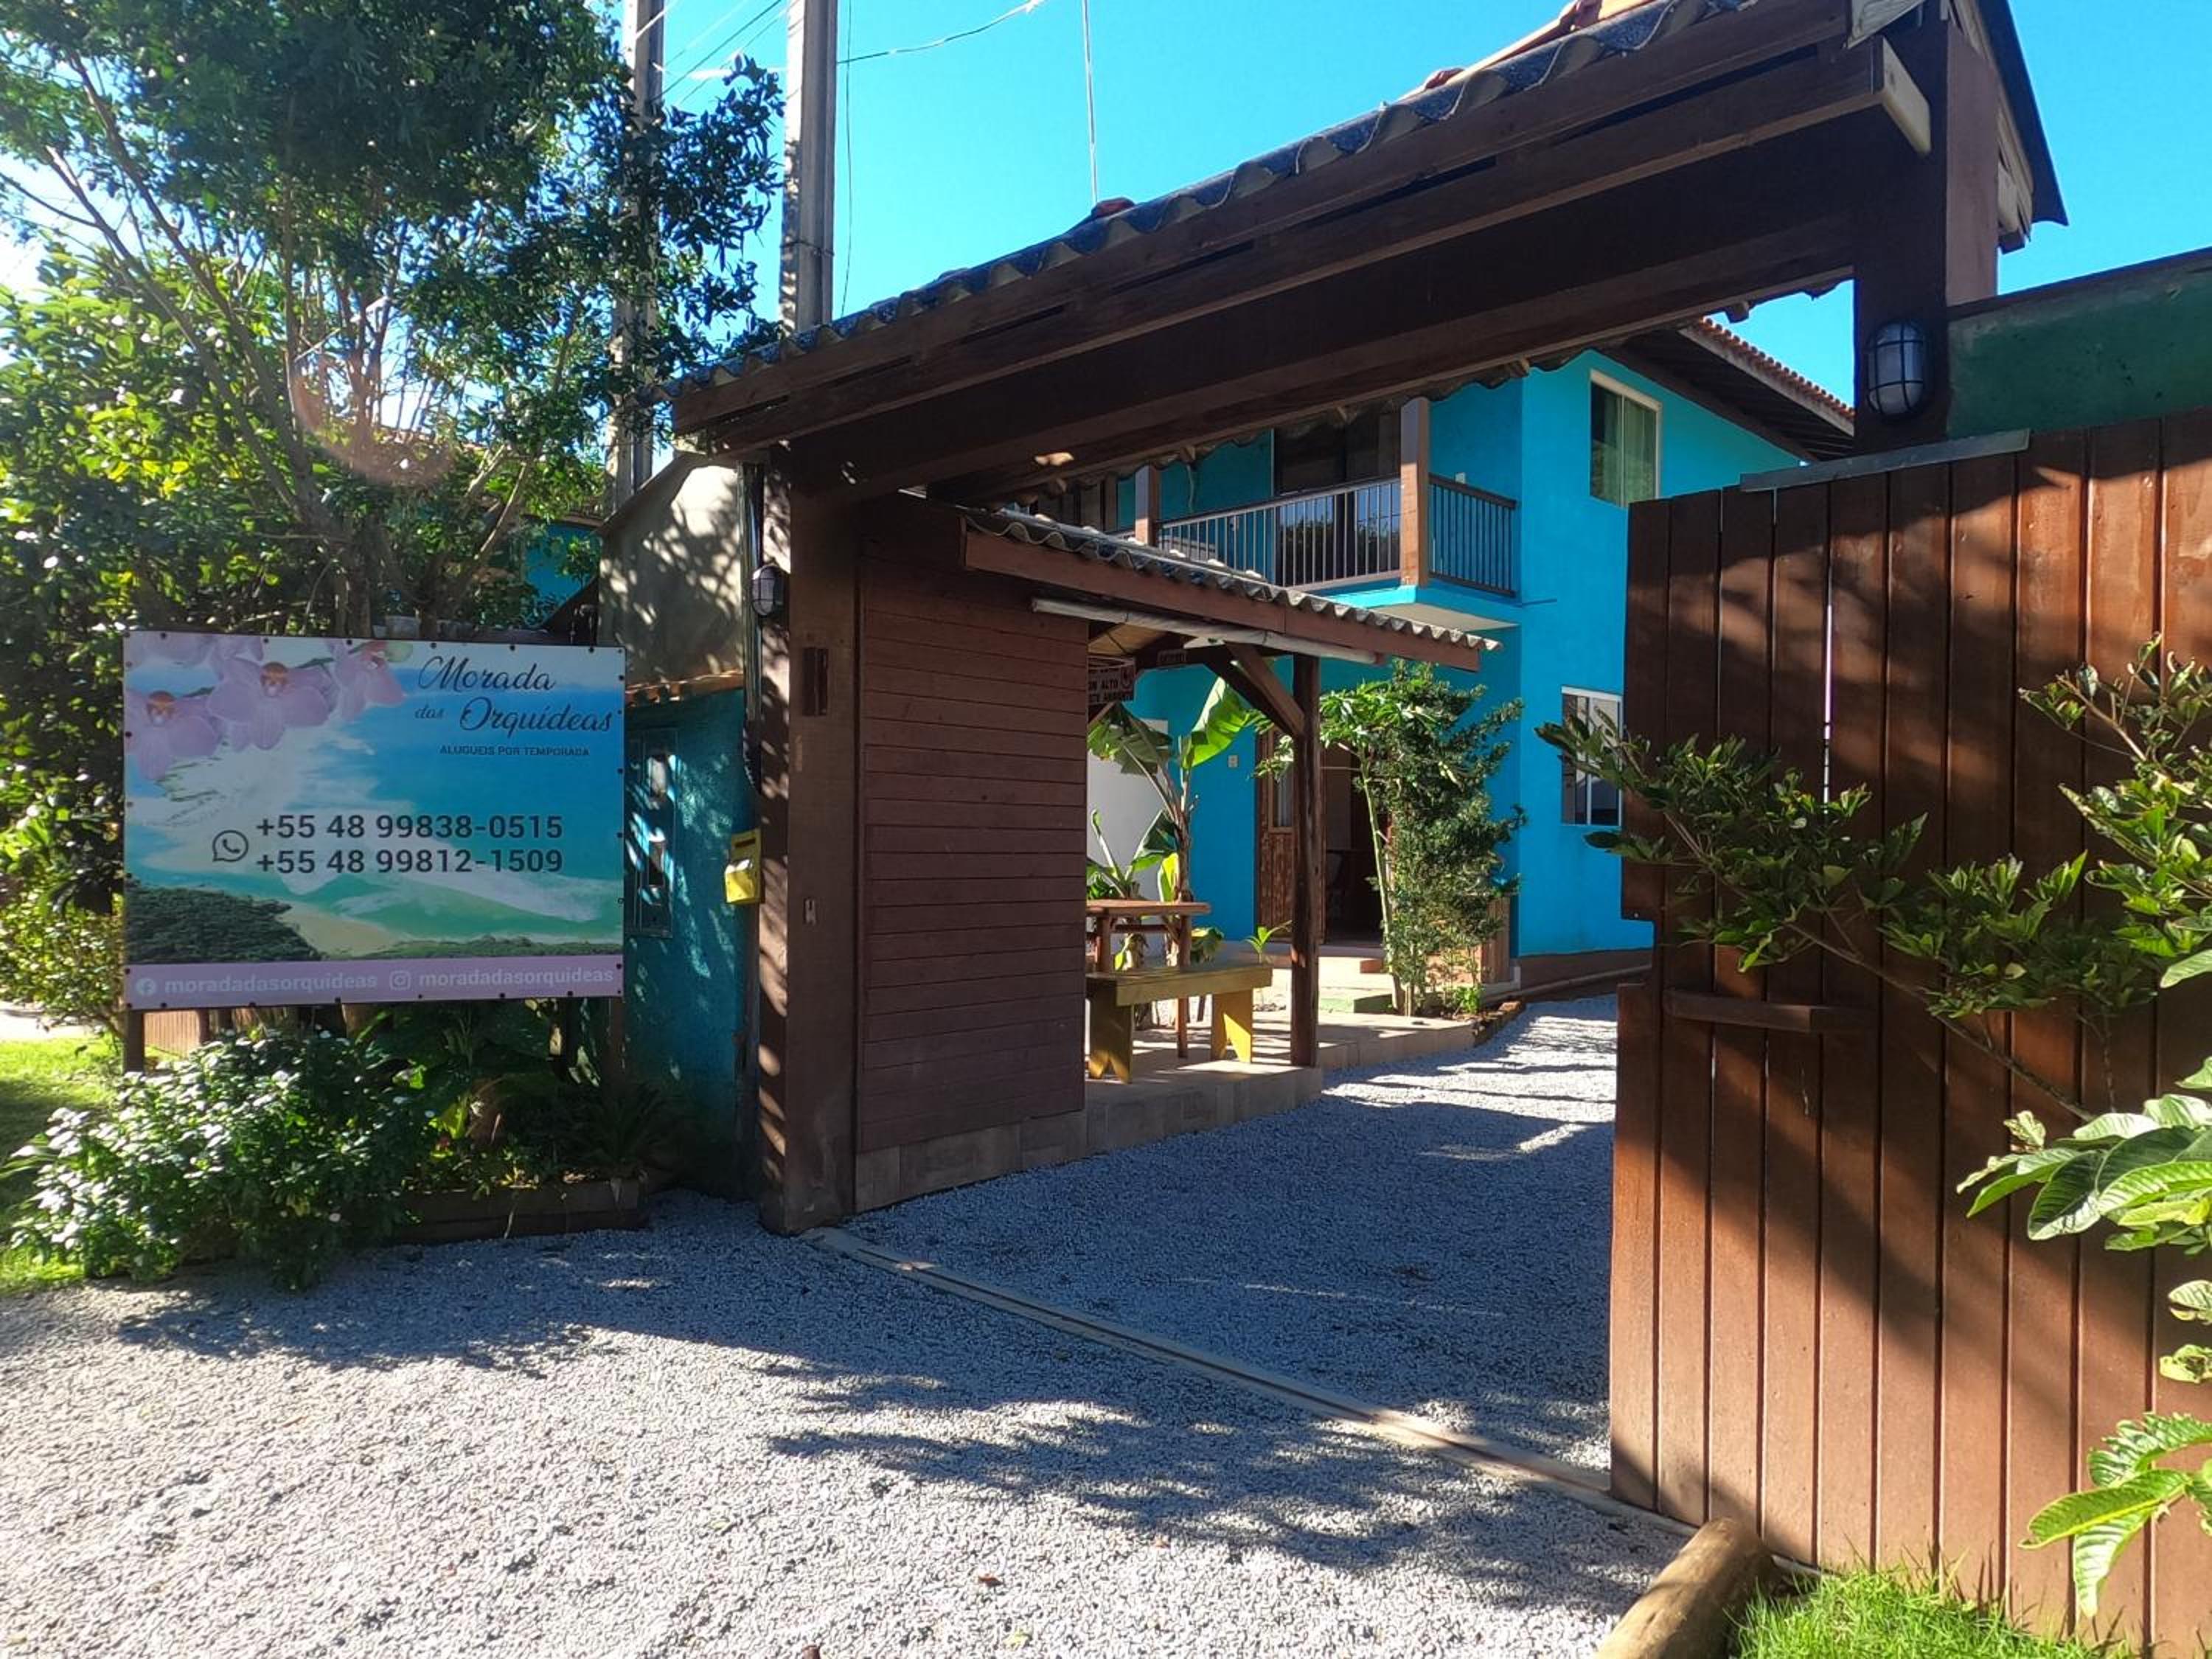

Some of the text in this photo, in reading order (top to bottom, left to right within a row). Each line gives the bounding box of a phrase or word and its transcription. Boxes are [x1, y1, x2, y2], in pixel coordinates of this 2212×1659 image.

[418, 655, 556, 692] Morada
[415, 703, 445, 720] das
[498, 745, 520, 756] POR
[524, 746, 589, 757] TEMPORADA
[256, 815, 563, 838] +55 48 99838-0515
[256, 849, 563, 873] +55 48 99812-1509
[164, 973, 378, 993] moradadasorquideas
[419, 967, 614, 990] moradadasorquideas
